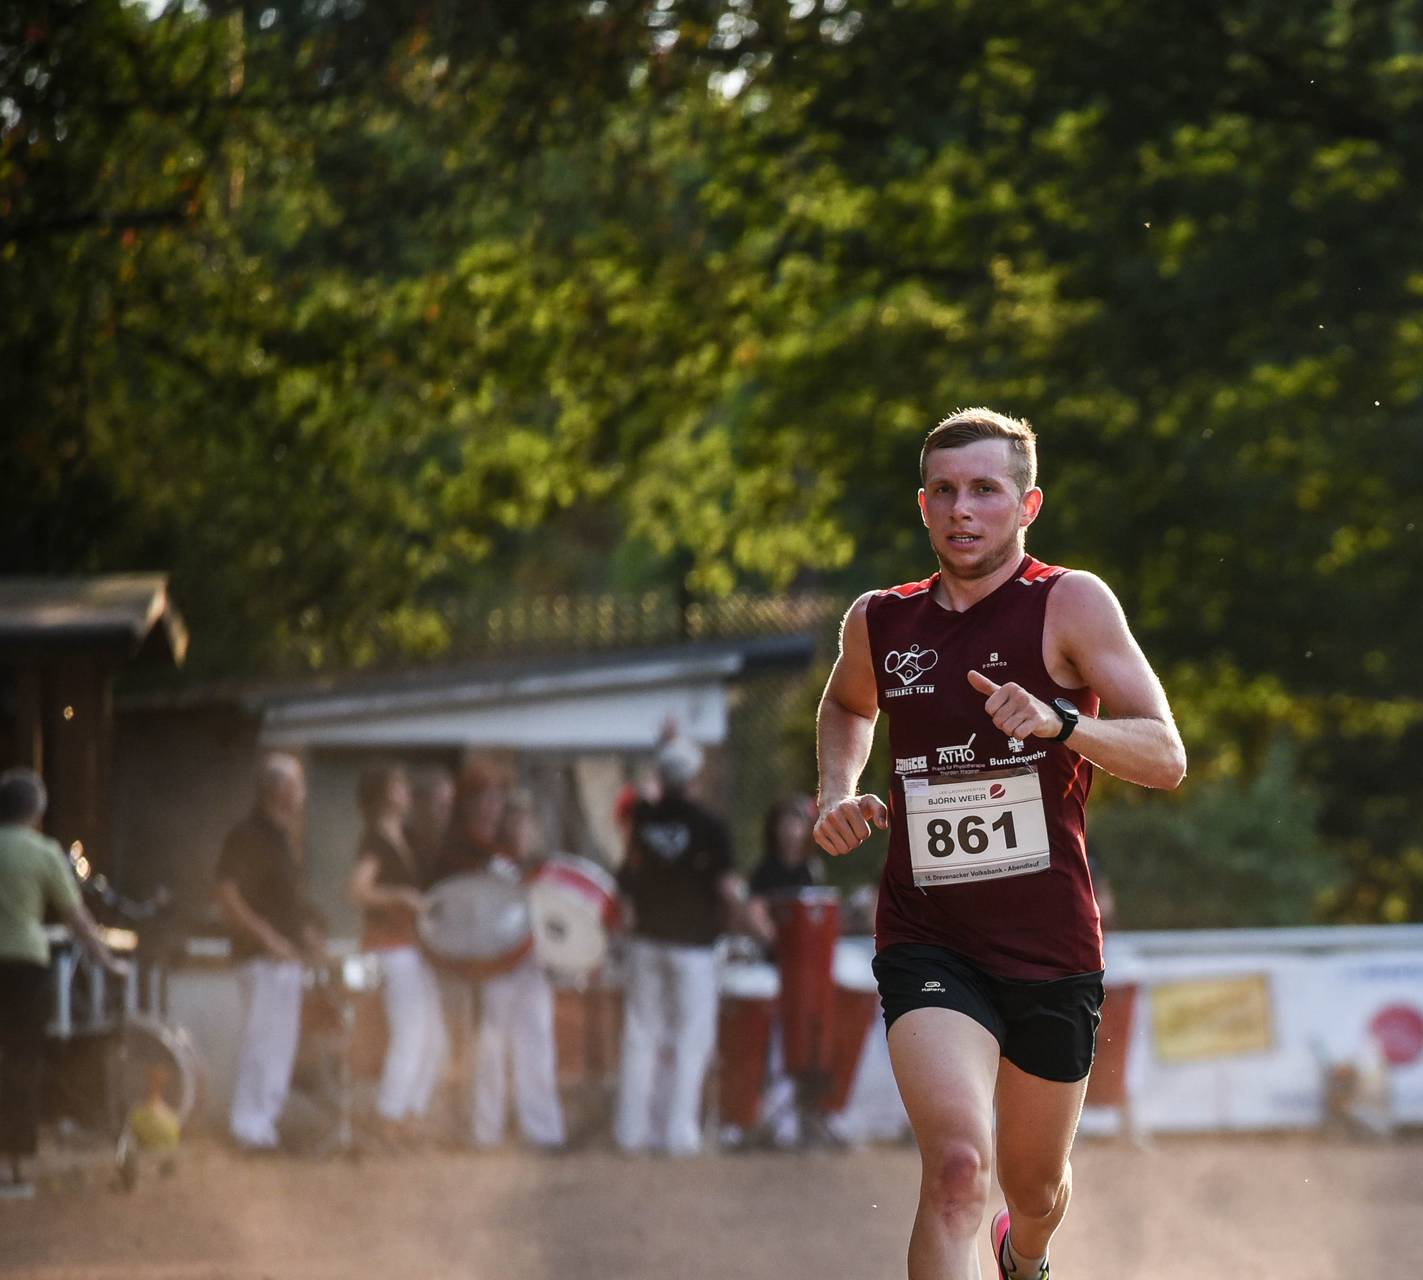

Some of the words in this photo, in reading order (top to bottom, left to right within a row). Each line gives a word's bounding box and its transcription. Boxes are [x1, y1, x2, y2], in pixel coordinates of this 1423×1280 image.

[916, 686, 935, 694] TEAM
[938, 746, 975, 764] ATHO
[989, 751, 1048, 766] Bundeswehr
[928, 796, 957, 805] BJÖRN
[959, 794, 987, 802] WEIER
[927, 811, 1017, 857] 861
[933, 872, 969, 881] Drevenacker
[971, 867, 1003, 876] Volksbank
[1007, 861, 1039, 871] Abendlauf
